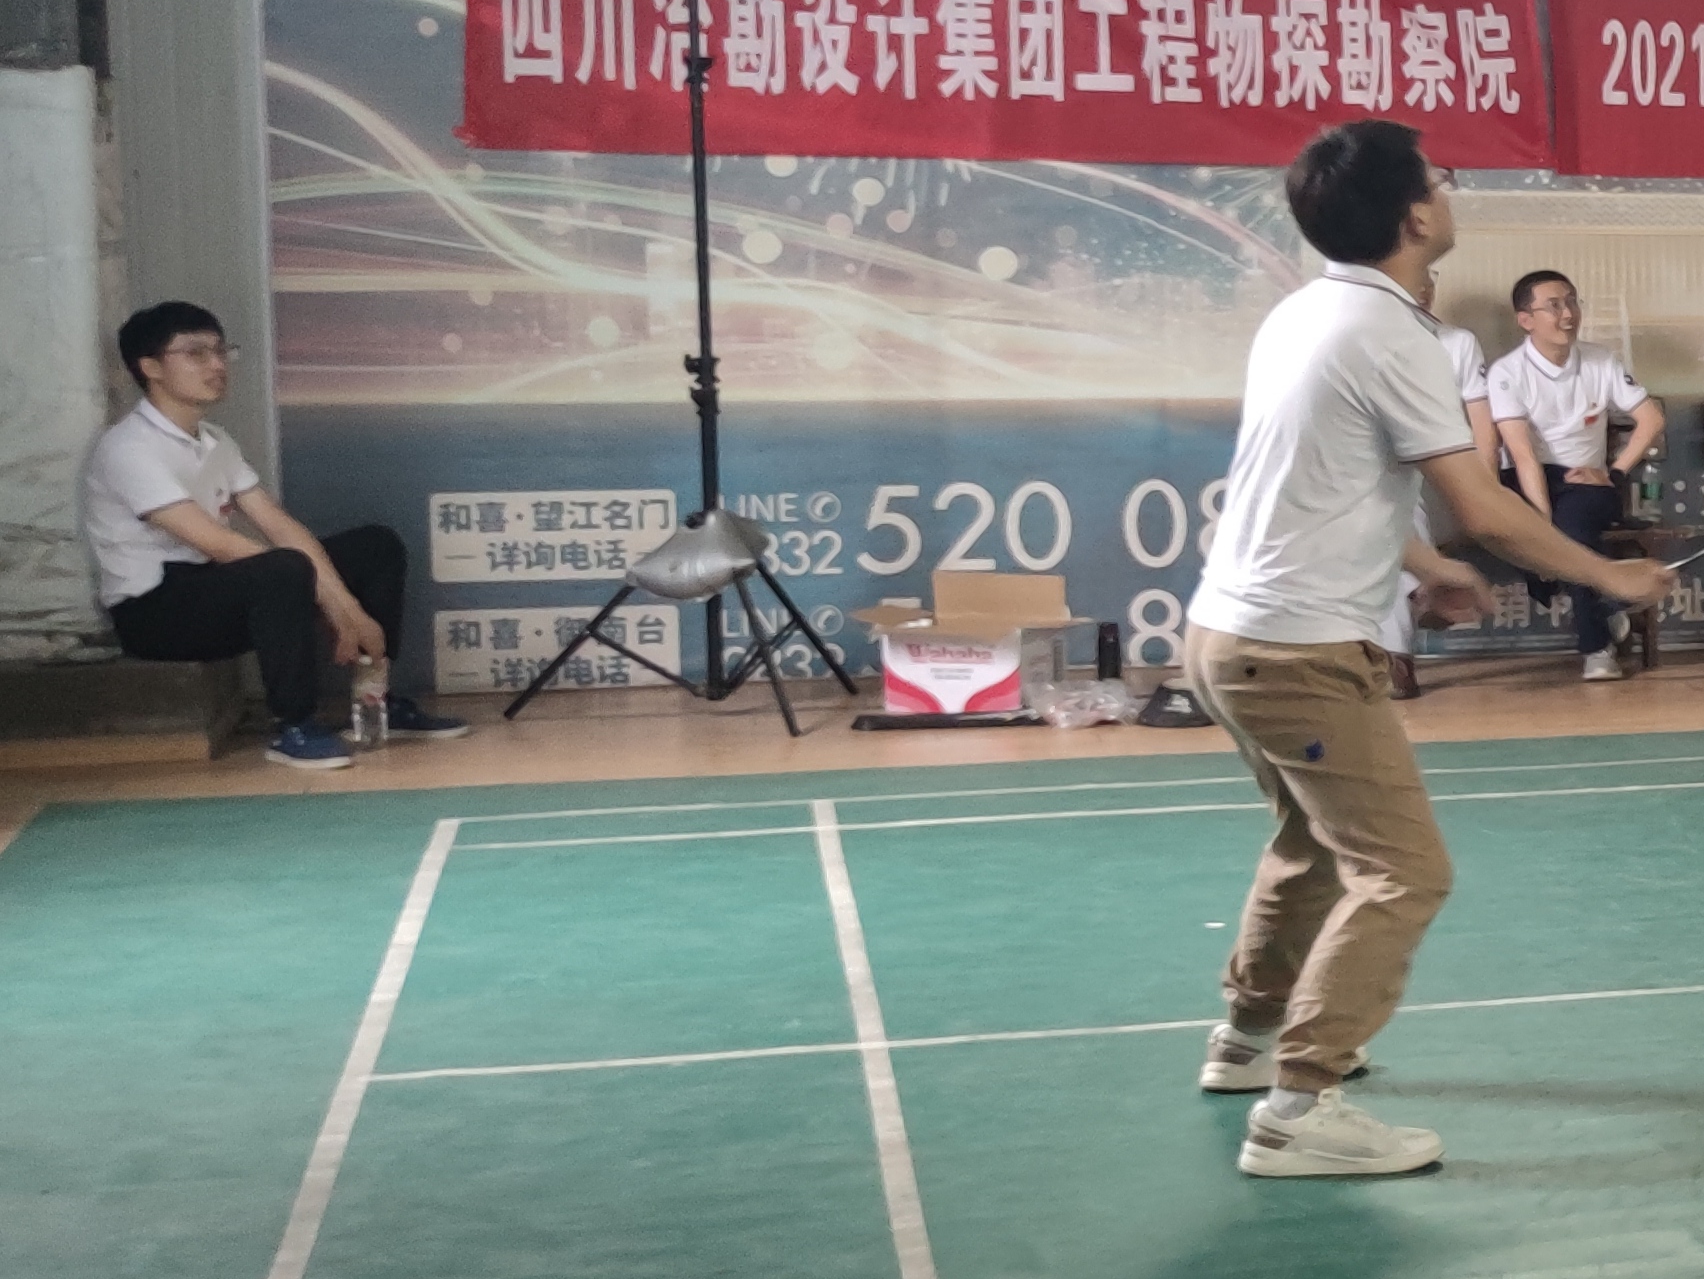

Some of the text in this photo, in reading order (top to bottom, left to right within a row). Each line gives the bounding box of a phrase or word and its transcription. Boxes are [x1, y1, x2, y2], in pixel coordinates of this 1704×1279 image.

[486, 540, 628, 572] 详询电话
[856, 479, 1073, 576] 520
